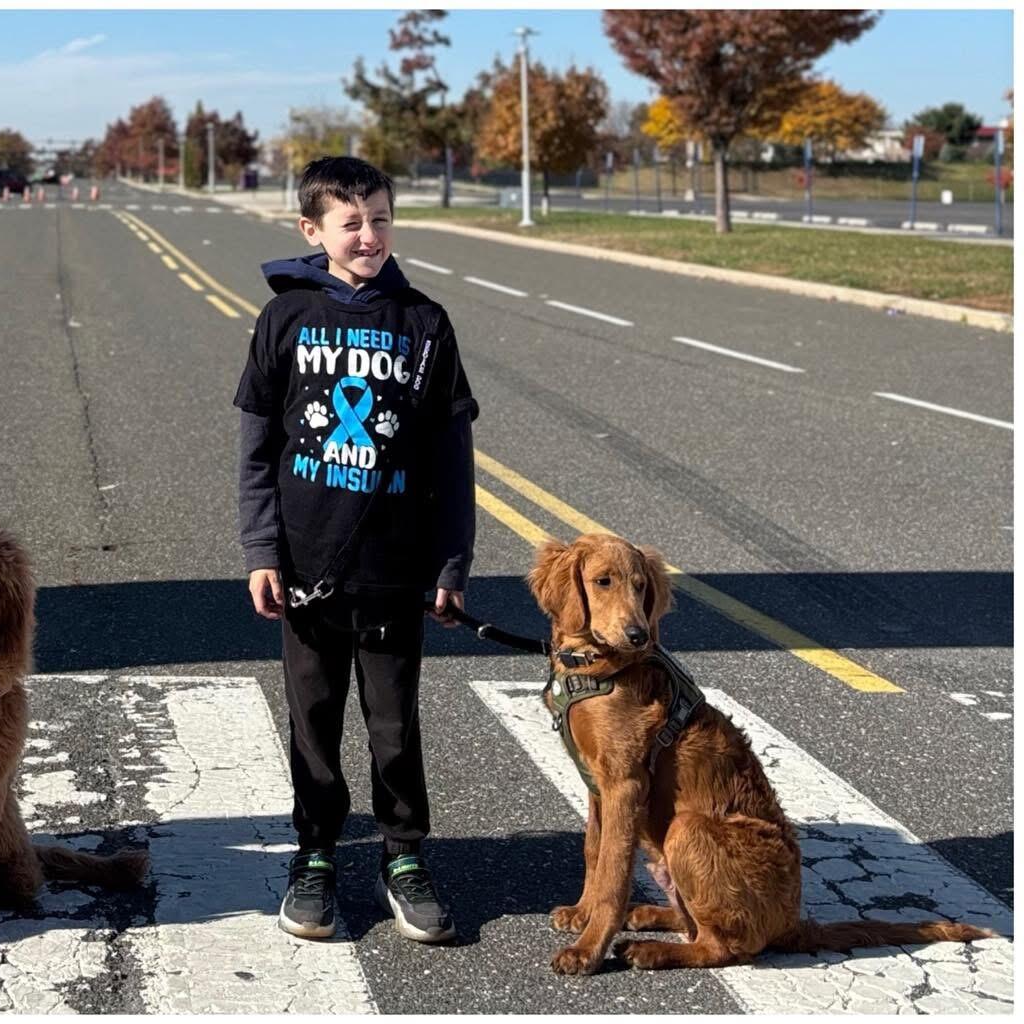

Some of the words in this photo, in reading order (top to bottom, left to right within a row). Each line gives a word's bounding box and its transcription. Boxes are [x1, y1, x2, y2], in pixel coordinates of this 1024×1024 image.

[298, 327, 329, 345] ALL
[336, 328, 341, 345] I
[347, 329, 392, 350] NEED
[398, 335, 410, 356] IS
[297, 345, 343, 374] MY
[348, 349, 410, 384] DOG
[323, 441, 376, 469] AND
[293, 454, 320, 482] MY
[326, 464, 406, 494] INSUN
